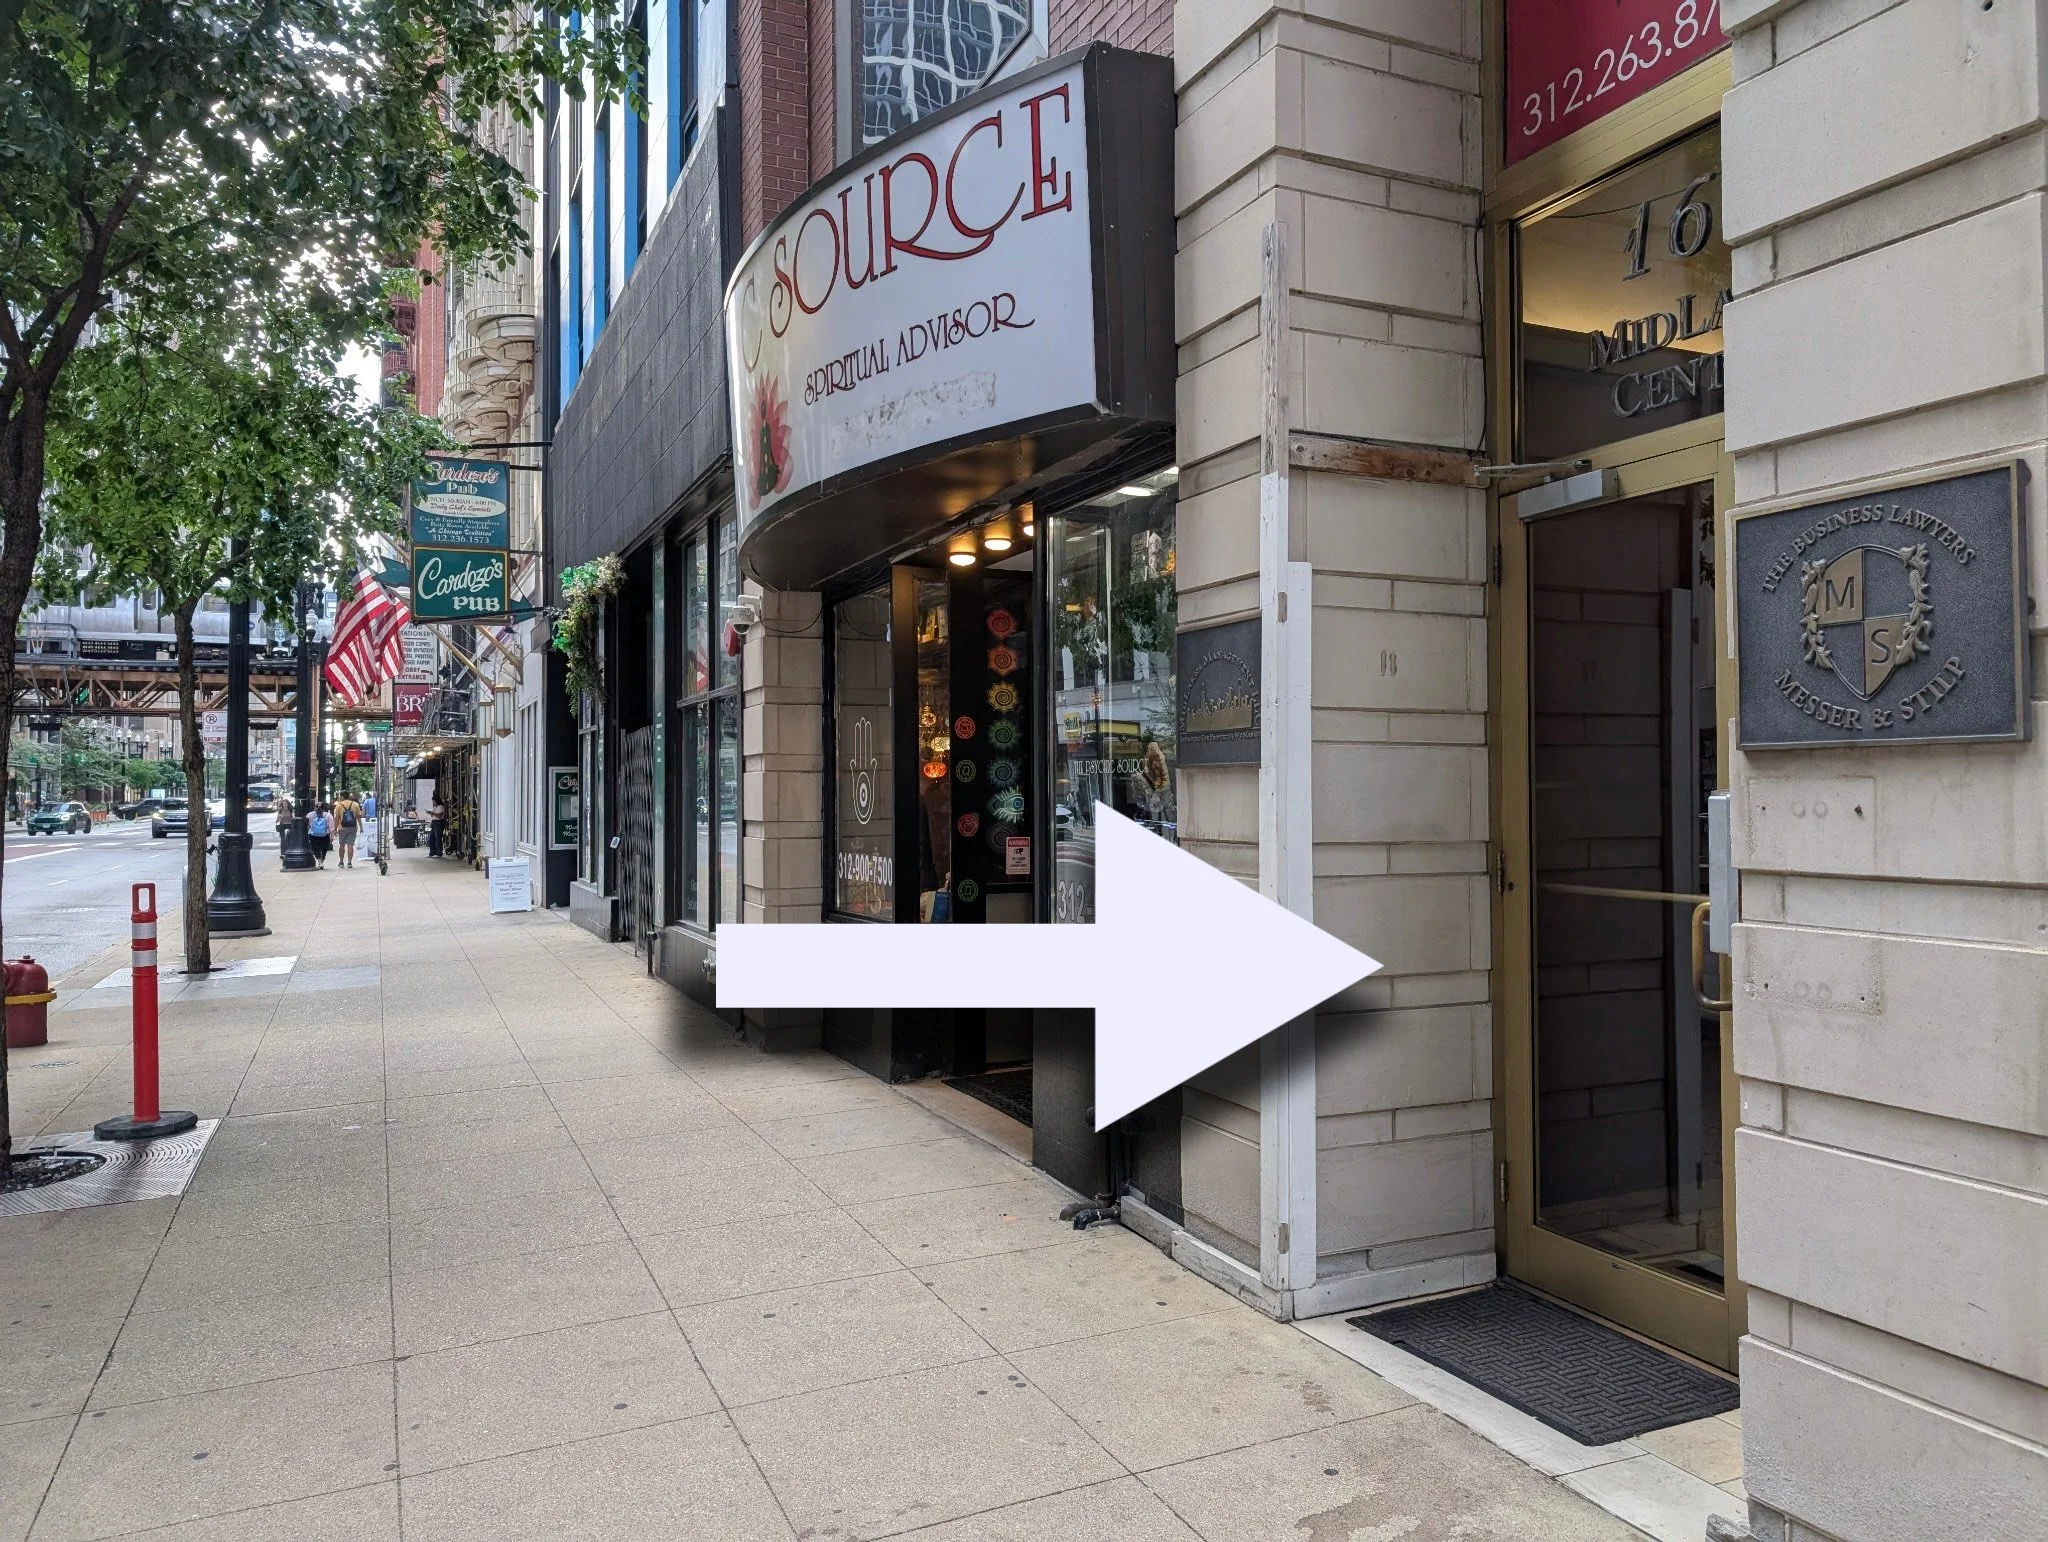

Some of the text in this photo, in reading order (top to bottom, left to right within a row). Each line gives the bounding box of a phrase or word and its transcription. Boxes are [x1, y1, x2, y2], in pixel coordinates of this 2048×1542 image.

[769, 83, 1072, 338] SOURCE
[804, 292, 1035, 406] SPIRITUAL ADVISOR
[446, 481, 478, 495] Pub
[432, 534, 490, 544] 312.236.1573
[1761, 503, 1977, 594] THE BUSINESS LAWYERS
[418, 557, 503, 600] Cardozo's
[1825, 576, 1855, 613] M
[1871, 629, 1890, 665] S
[1774, 656, 1967, 731] MESSER & STILP
[1074, 759, 1150, 774] THE PSYCHIC SOURCE
[838, 852, 893, 887] 312-900-7500
